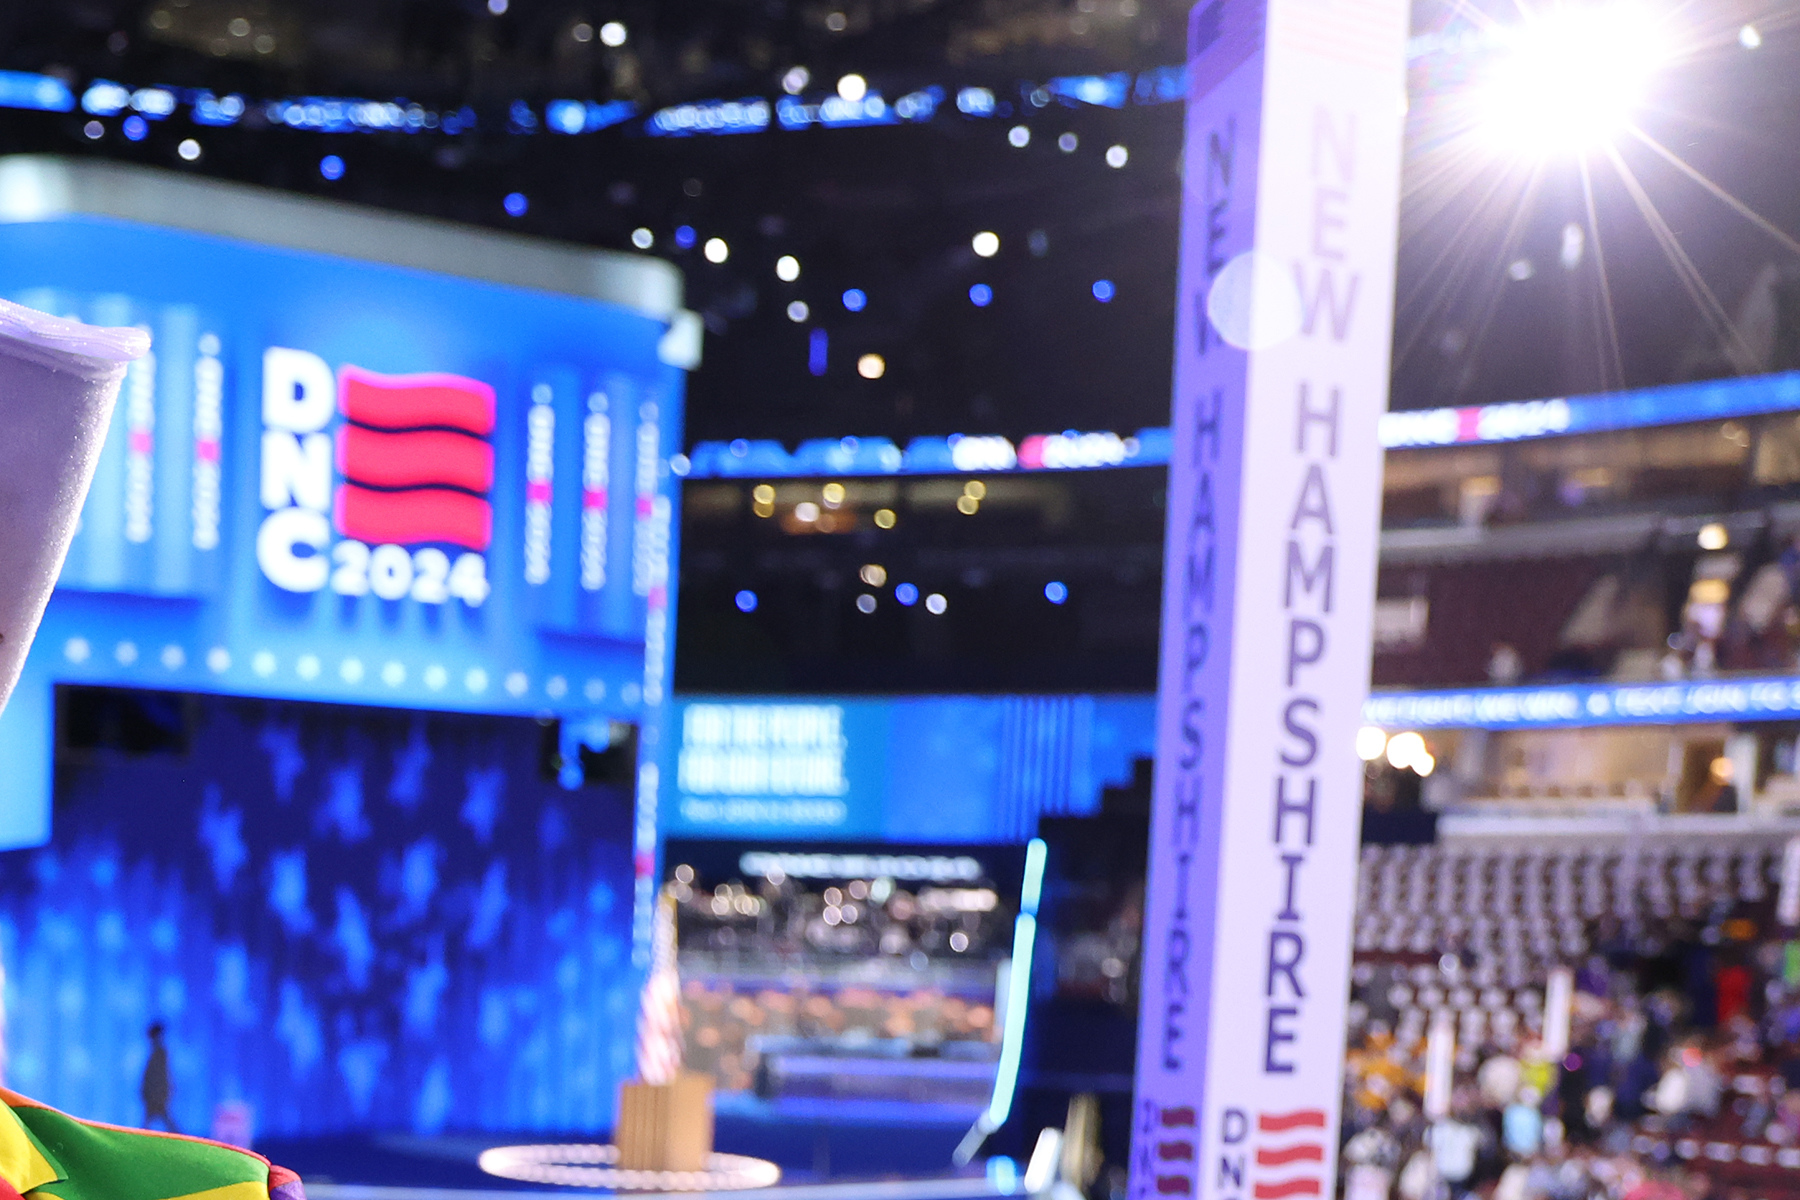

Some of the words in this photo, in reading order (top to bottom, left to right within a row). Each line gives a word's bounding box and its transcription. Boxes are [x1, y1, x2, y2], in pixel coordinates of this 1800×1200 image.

[1292, 104, 1360, 342] NEW
[255, 346, 335, 593] DNC
[331, 539, 490, 607] 2024
[1264, 384, 1341, 1075] HAMPSHIRE
